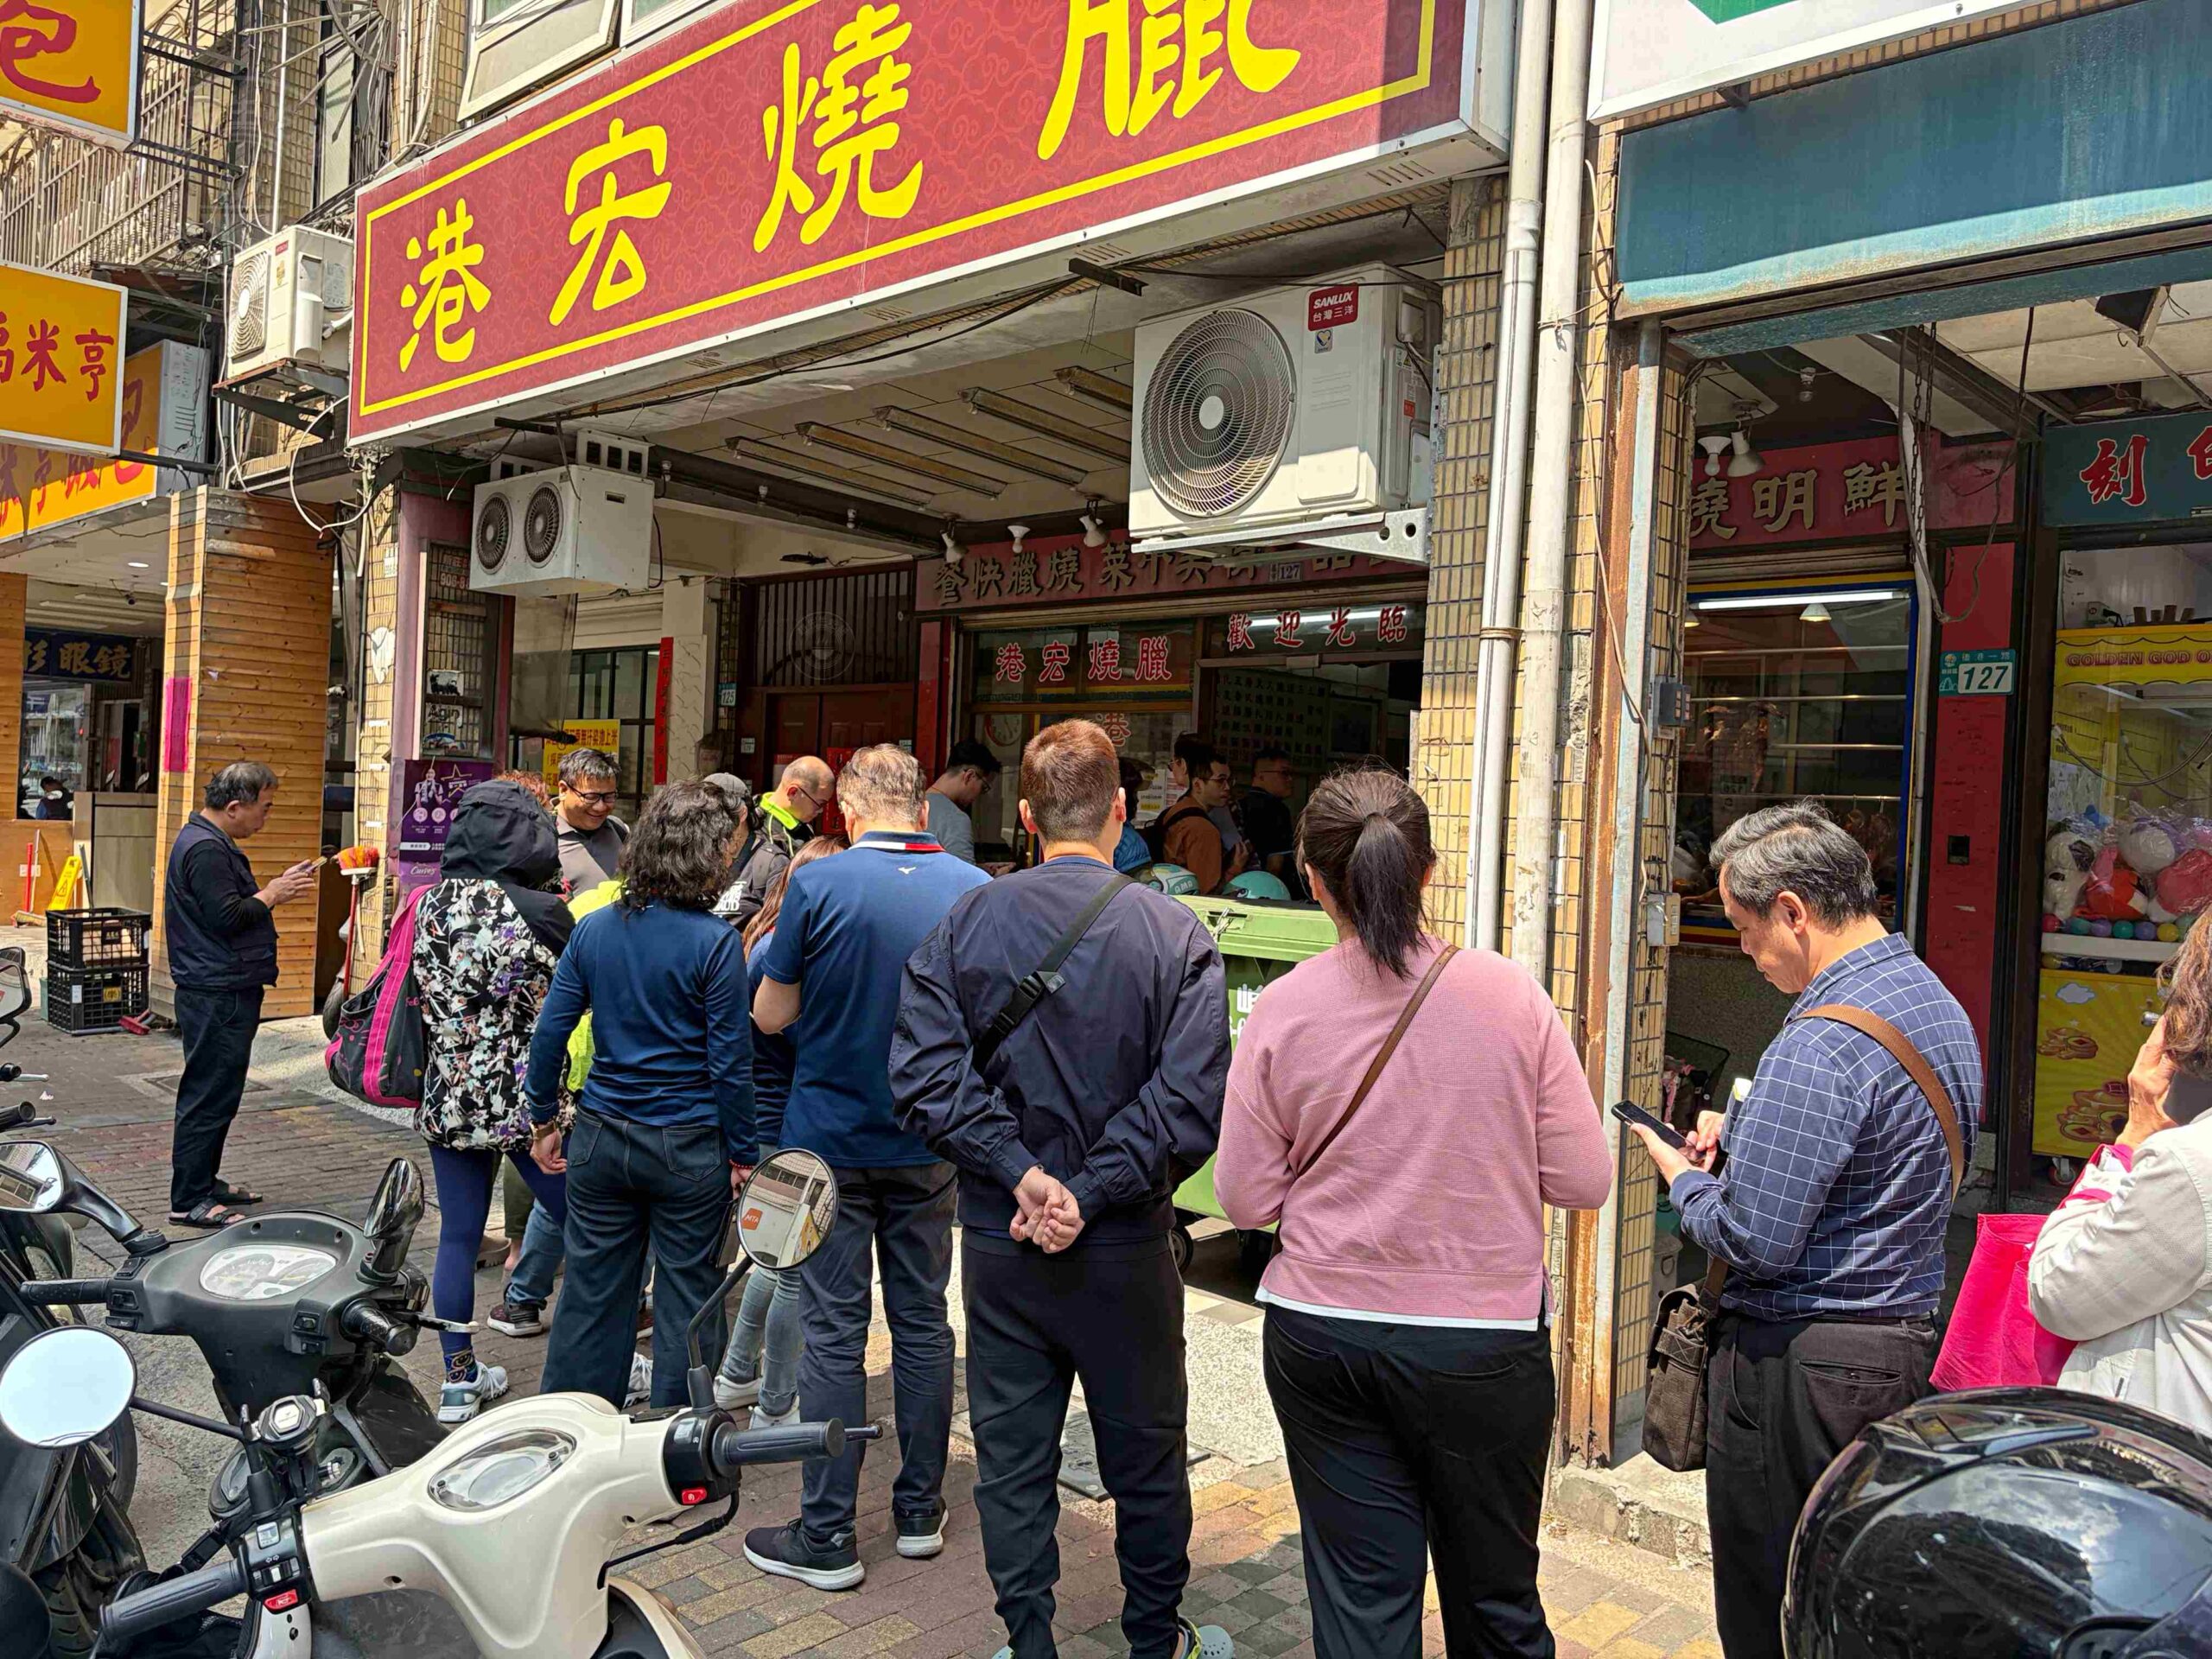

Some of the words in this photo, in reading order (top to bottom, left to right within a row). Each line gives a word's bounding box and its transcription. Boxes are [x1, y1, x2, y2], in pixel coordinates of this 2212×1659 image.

[1313, 291, 1353, 308] SANLUX
[1313, 305, 1354, 322] 台灣三洋
[1281, 564, 1300, 579] 127
[1228, 606, 1407, 652] 歡迎光臨
[996, 636, 1172, 683] 港宏燒臘
[2066, 652, 2145, 667] GOLDEN
[2148, 651, 2191, 664] GOD
[1963, 665, 2009, 690] 127
[722, 690, 734, 704] 125
